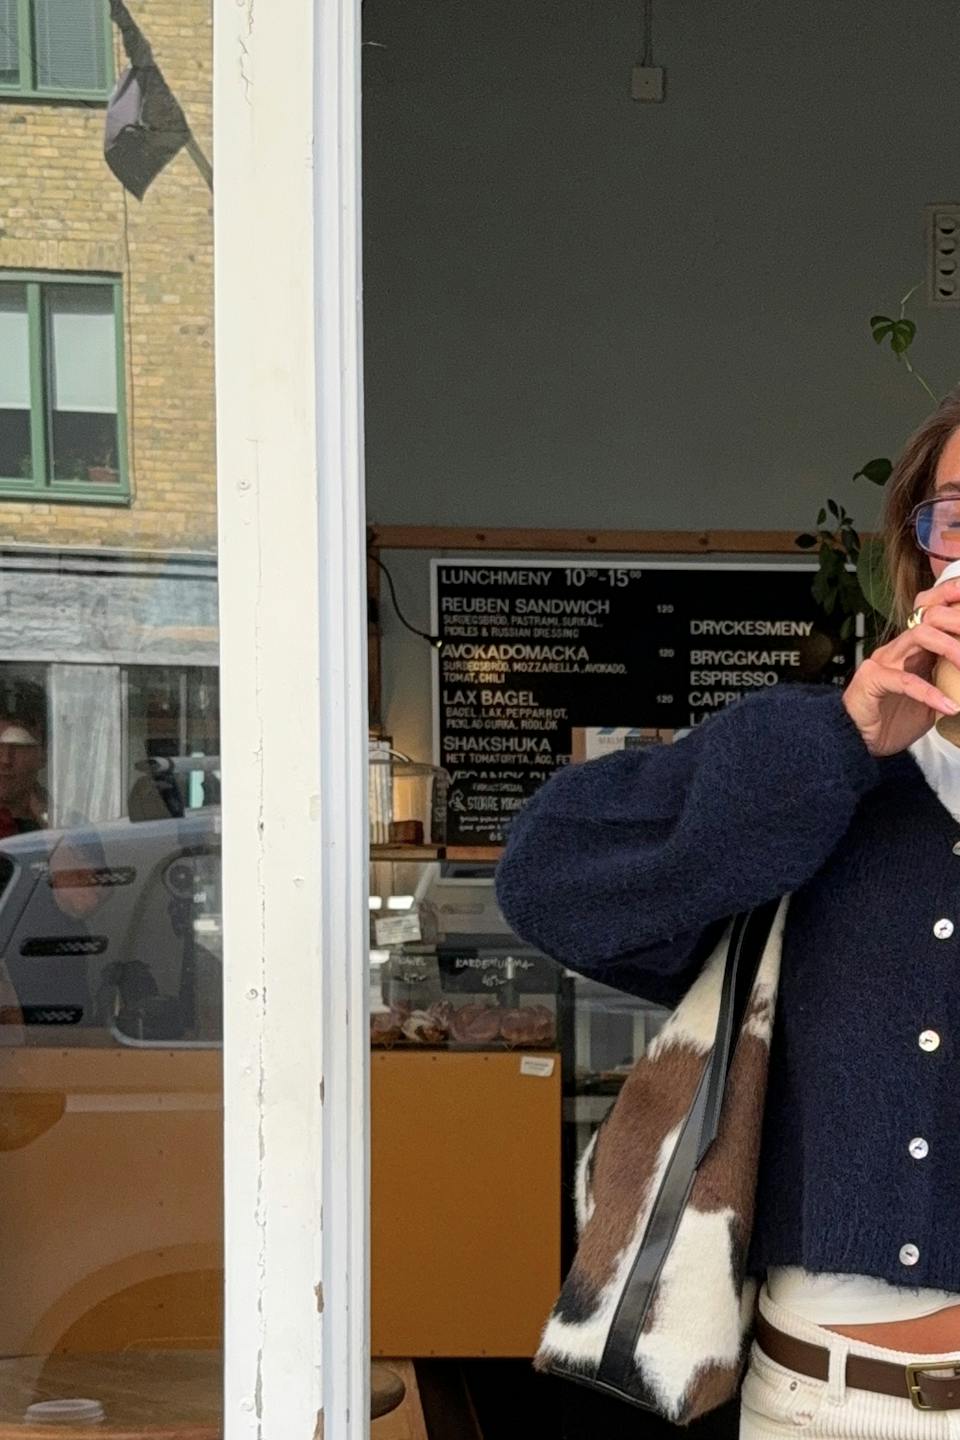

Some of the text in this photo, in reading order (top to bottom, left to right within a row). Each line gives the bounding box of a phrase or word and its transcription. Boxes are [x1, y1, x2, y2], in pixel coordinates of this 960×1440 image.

[441, 569, 552, 586] LUNCHMENY
[441, 597, 510, 613] REUBEN
[515, 599, 610, 614] SANDWICH
[491, 627, 531, 638] RUSSIAN
[690, 621, 814, 636] DRYCKESMENY
[441, 644, 589, 661] AVOKADOMACKA
[690, 651, 800, 666] BRYGGKAFFE
[479, 672, 505, 684] CHILI
[690, 671, 778, 686] ESPRESSO
[443, 690, 477, 705] LAX
[481, 691, 539, 706] BAGEL
[443, 736, 552, 752] SHAKSHUKA
